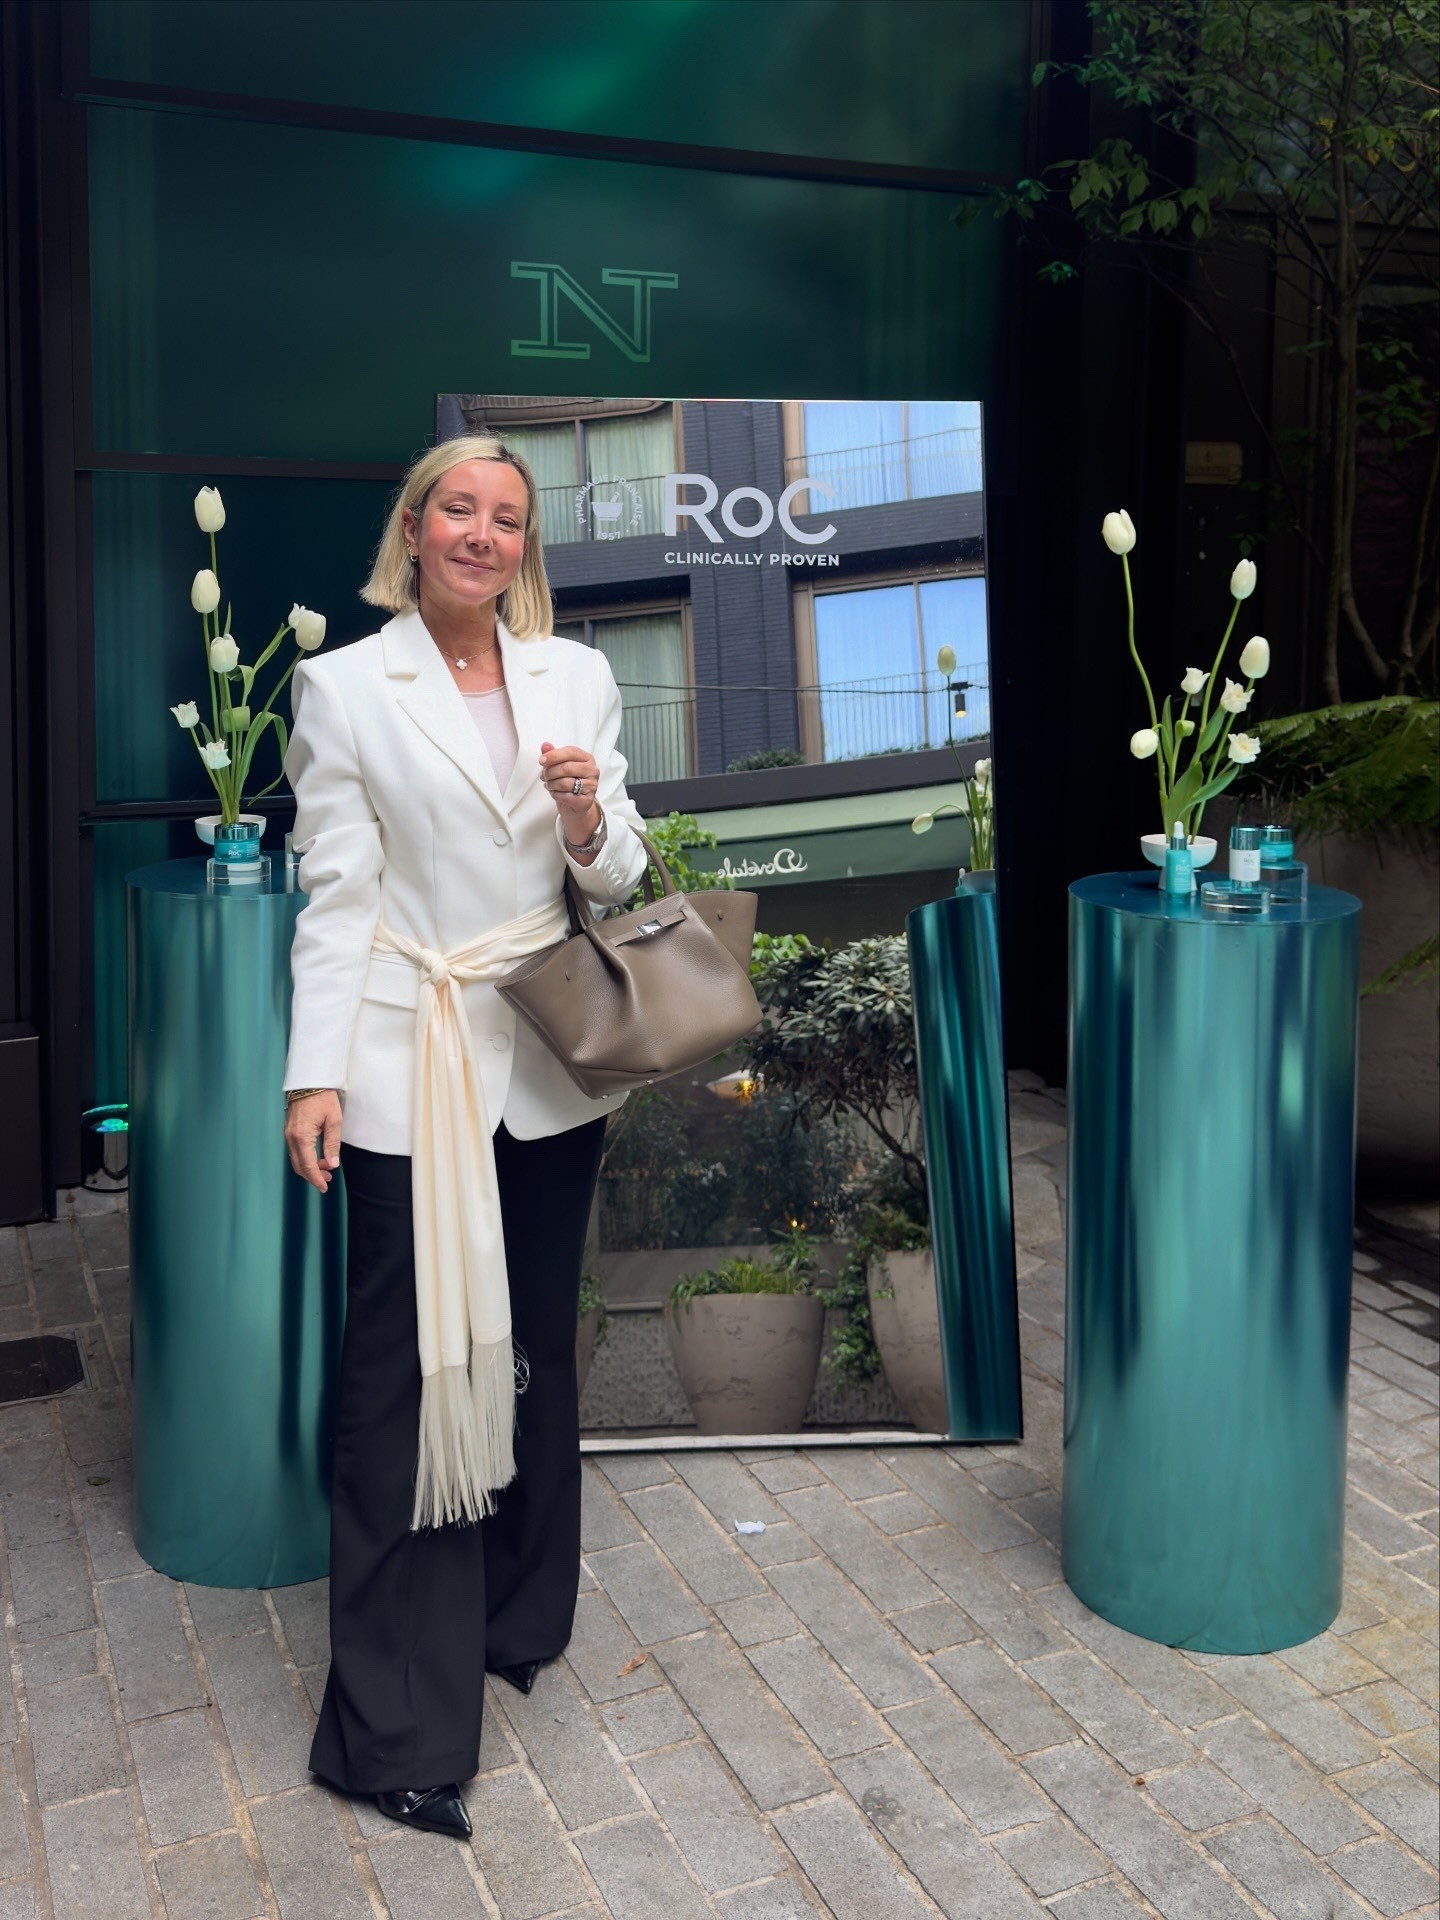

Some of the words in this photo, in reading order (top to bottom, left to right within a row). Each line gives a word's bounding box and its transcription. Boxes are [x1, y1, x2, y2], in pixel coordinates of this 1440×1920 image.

[575, 475, 609, 524] PHARMACIE
[664, 473, 838, 545] RoC
[597, 531, 621, 540] 1957
[664, 552, 764, 565] CLINICALLY
[769, 554, 840, 567] PROVEN
